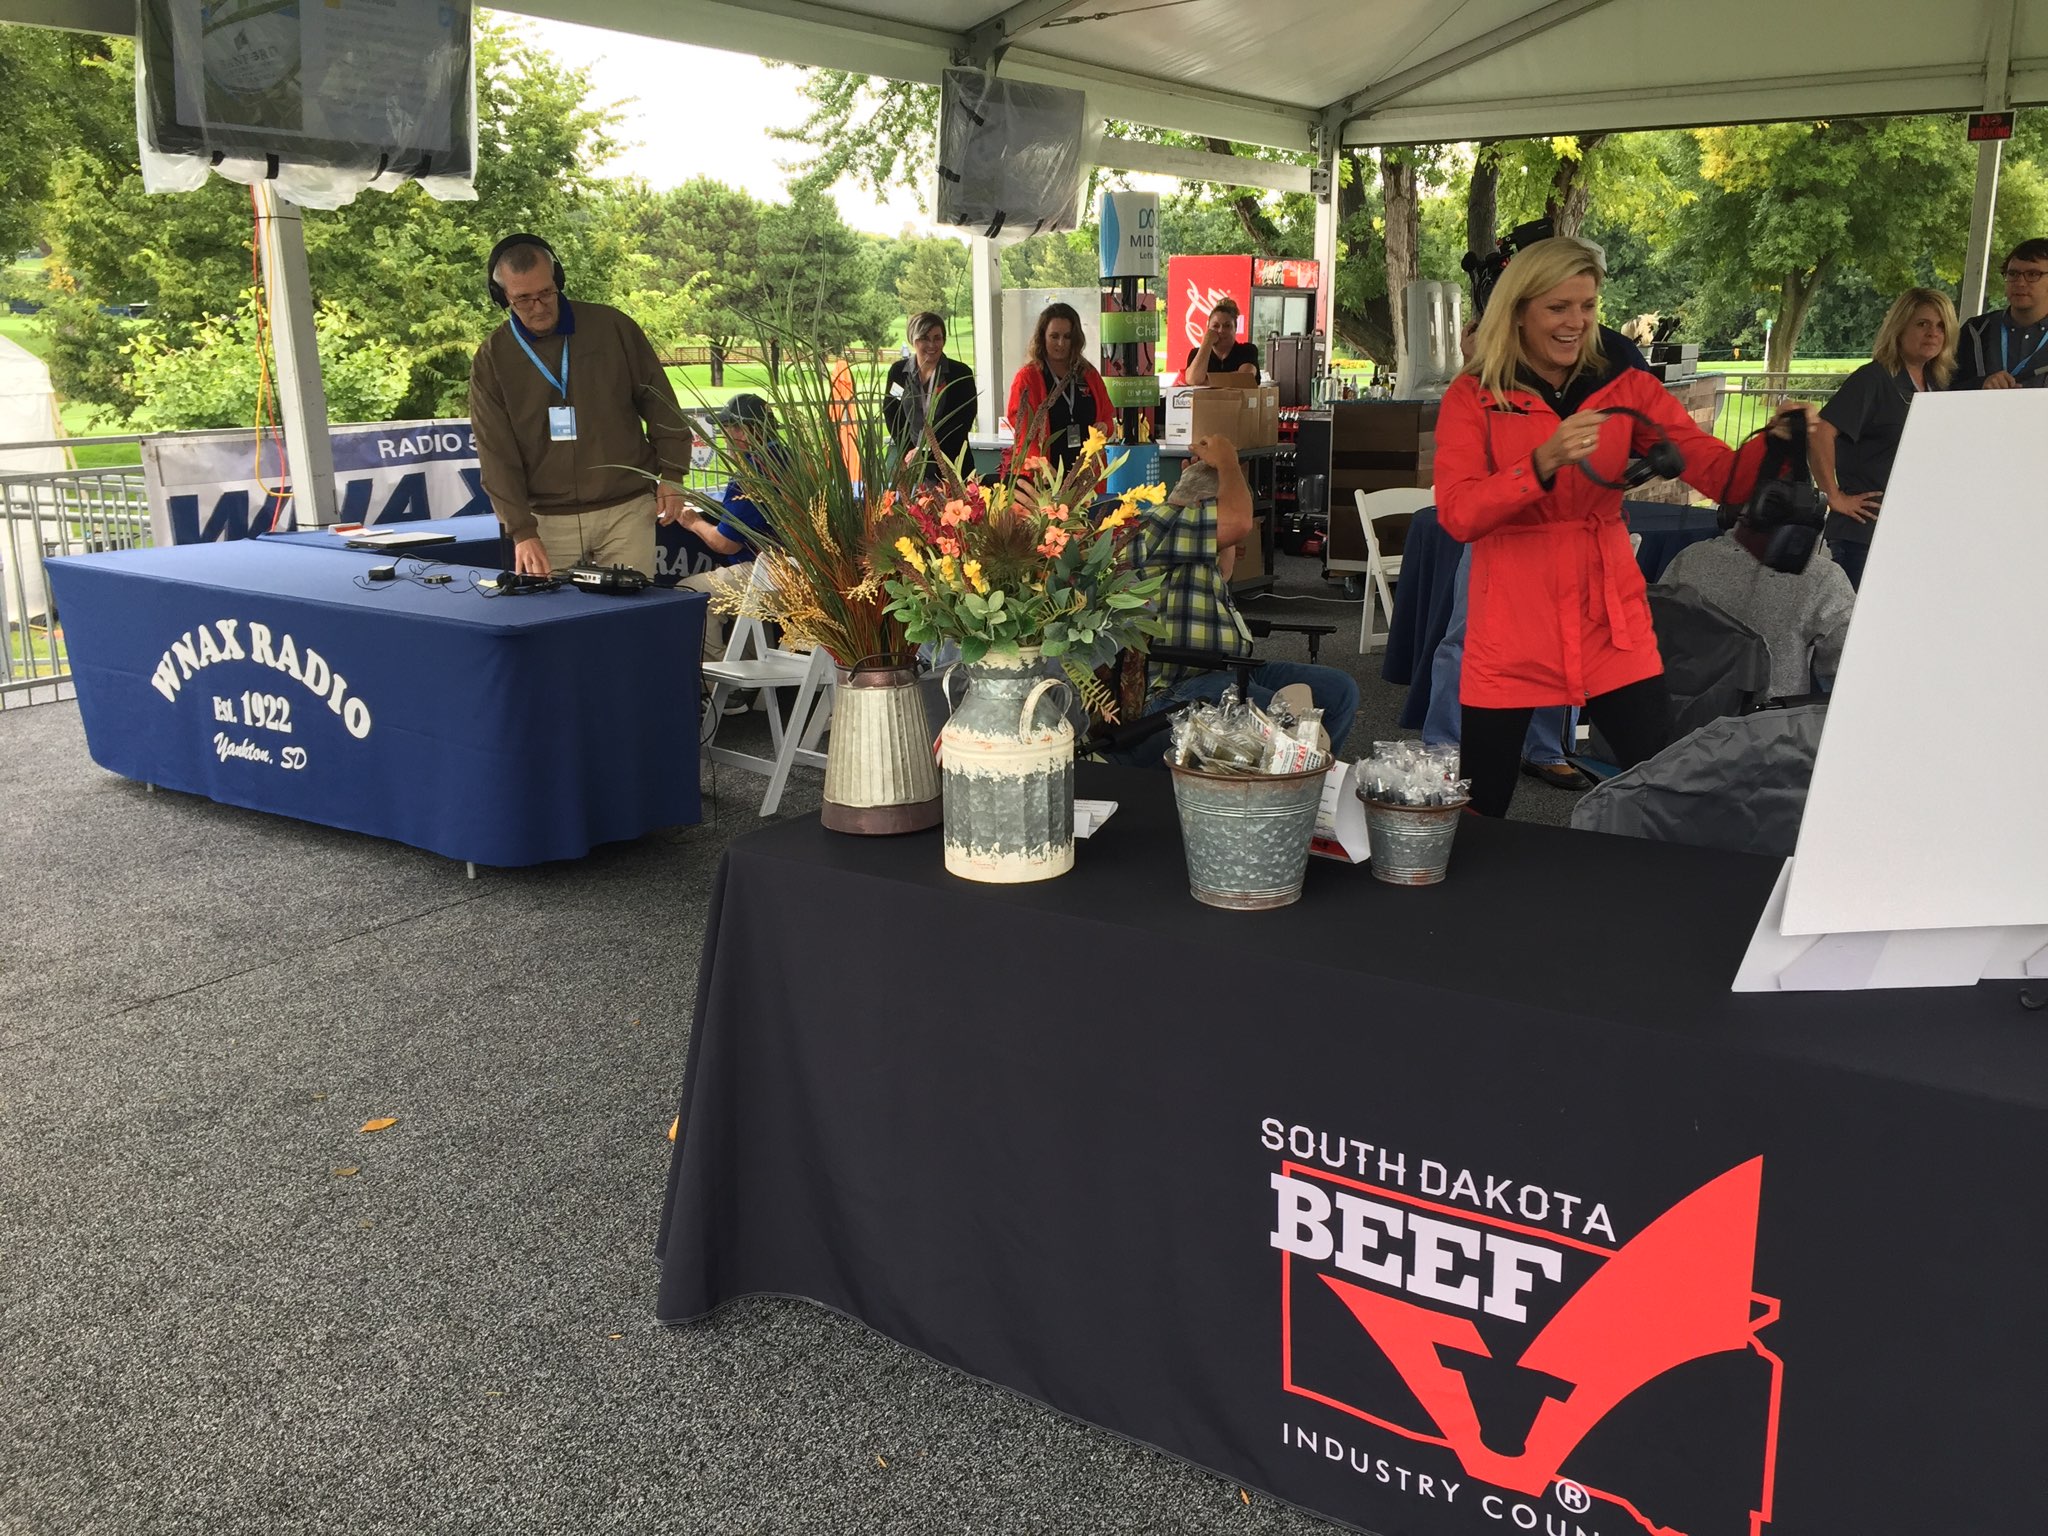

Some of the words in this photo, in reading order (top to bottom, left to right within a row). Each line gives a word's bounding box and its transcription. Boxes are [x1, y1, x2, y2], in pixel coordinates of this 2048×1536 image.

[377, 432, 462, 459] RADIO
[151, 618, 245, 703] WNAX
[249, 621, 371, 739] RADIO
[212, 696, 238, 724] Est.
[240, 690, 292, 733] 1922
[280, 746, 308, 770] SD
[1261, 1117, 1406, 1186] SOUTH
[1419, 1158, 1617, 1243] DAKOTA
[1270, 1172, 1563, 1323] BEEF
[1283, 1422, 1460, 1503] INDUSTRY
